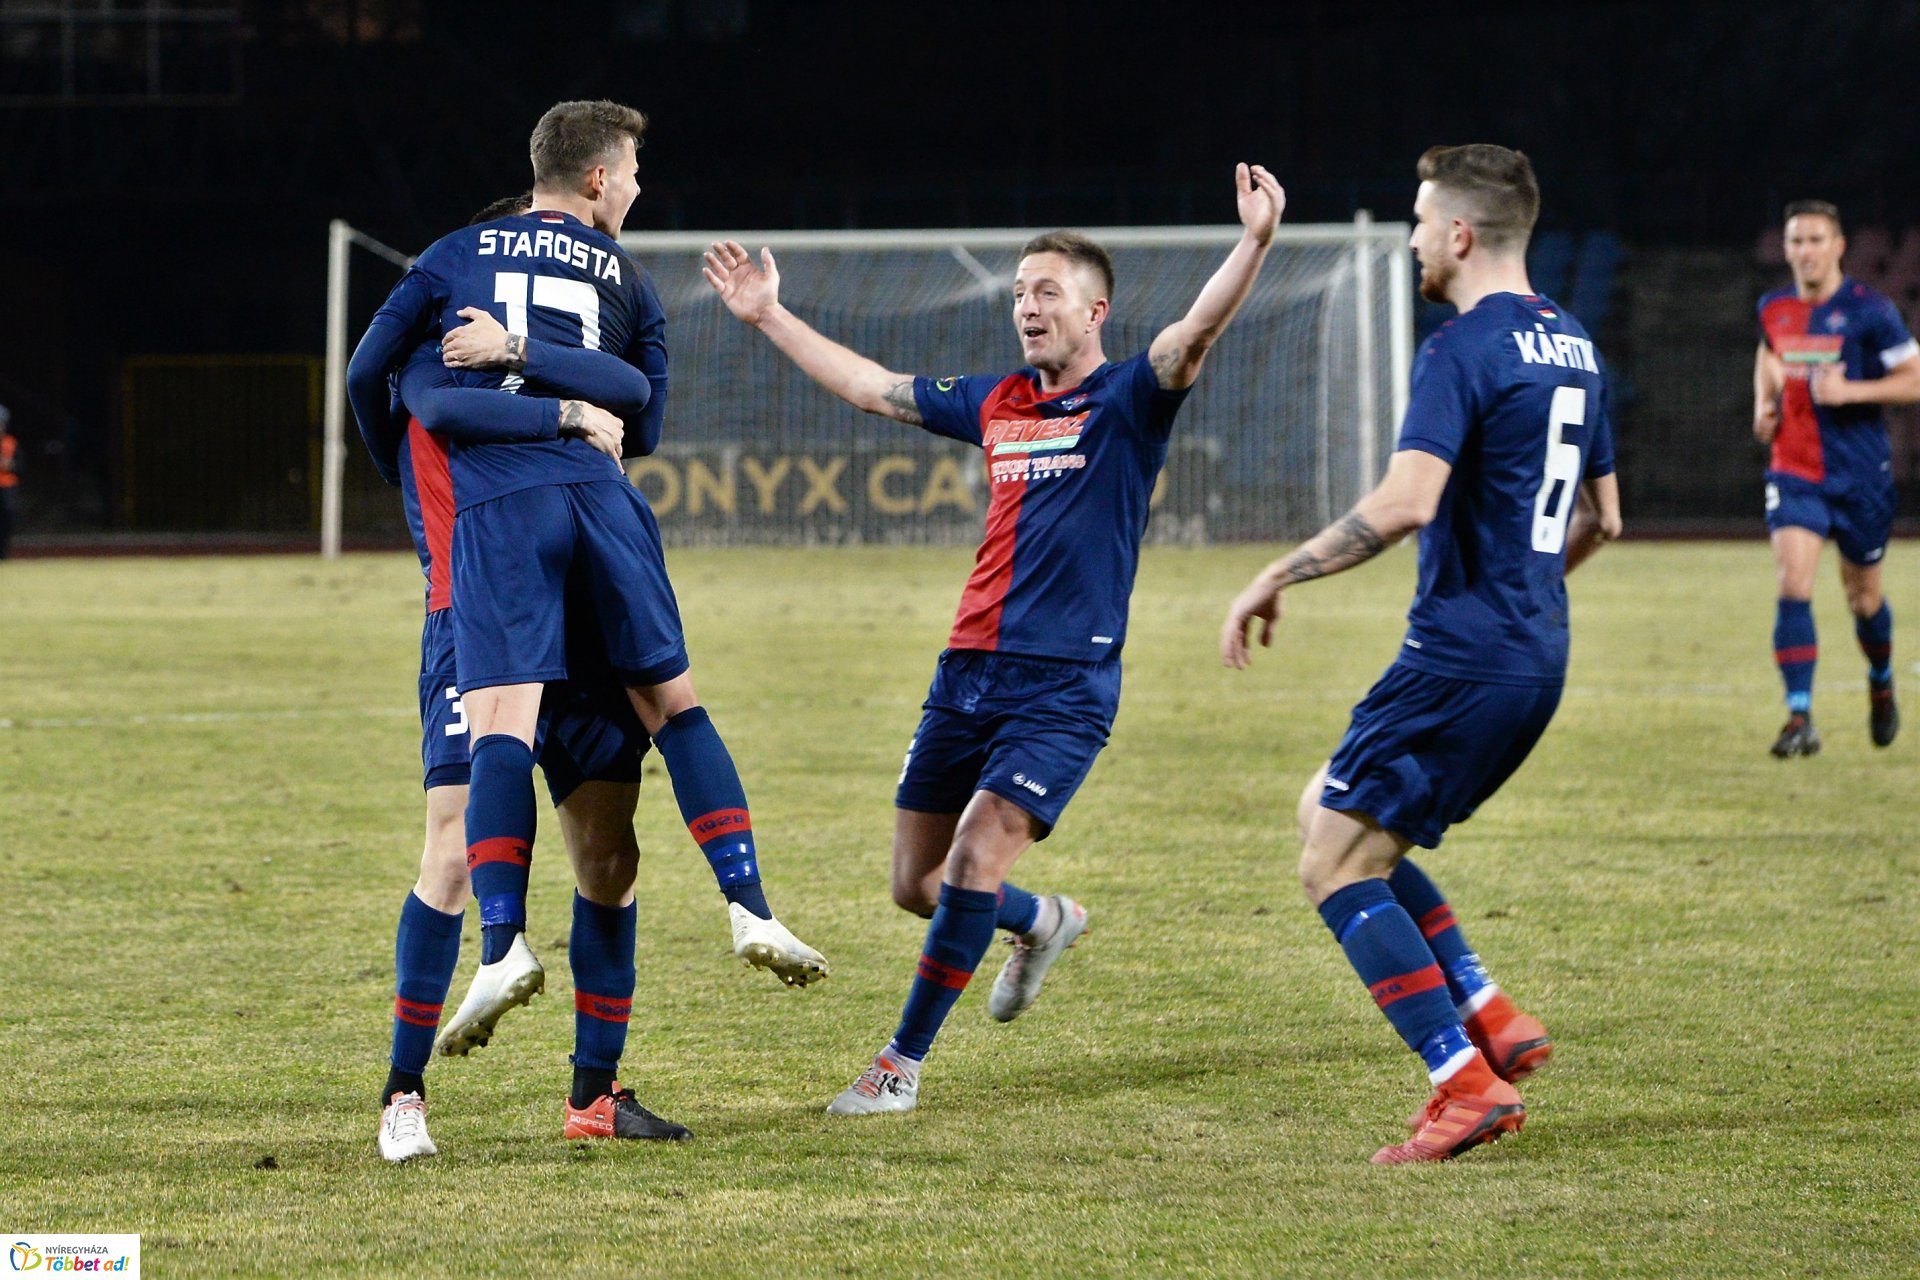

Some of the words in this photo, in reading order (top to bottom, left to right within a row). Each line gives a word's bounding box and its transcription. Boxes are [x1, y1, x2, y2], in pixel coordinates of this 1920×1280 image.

[478, 229, 621, 285] STAROSTA
[494, 272, 601, 394] 17
[628, 456, 849, 517] ONYX
[867, 456, 988, 514] CA
[1531, 386, 1586, 554] 6
[1023, 780, 1047, 796] JAKO
